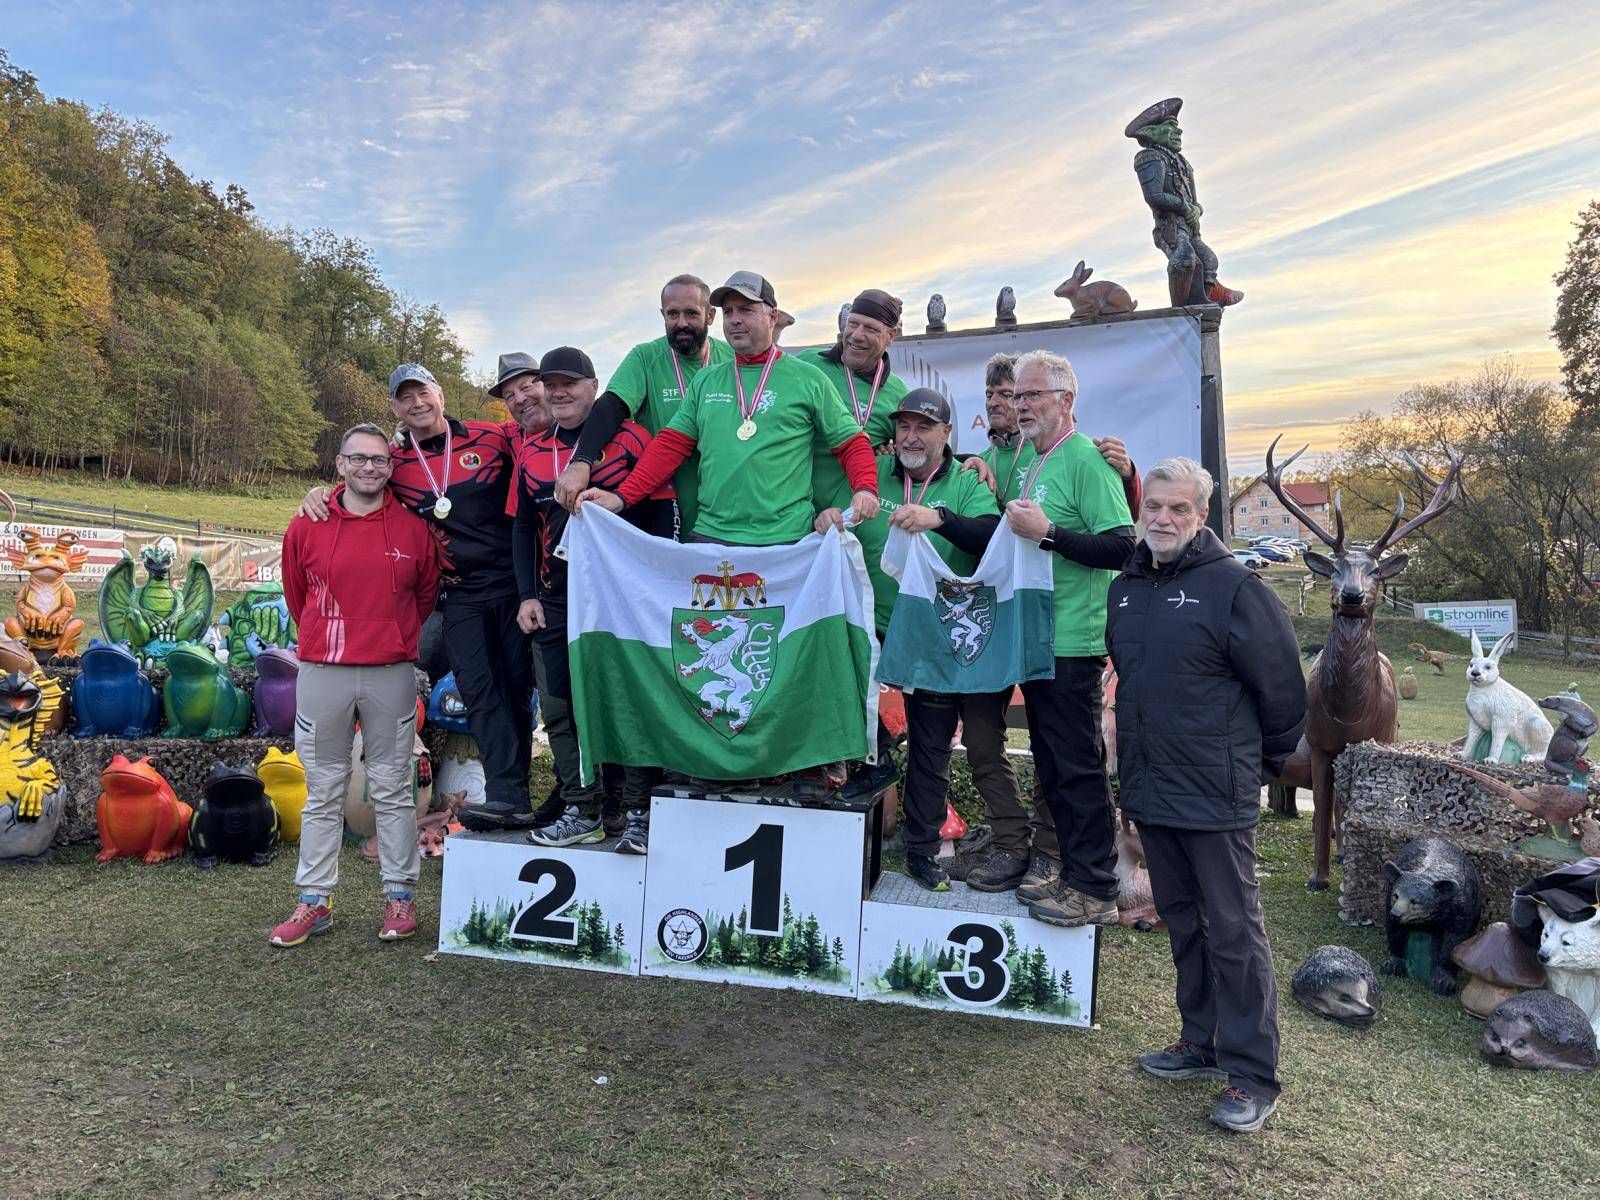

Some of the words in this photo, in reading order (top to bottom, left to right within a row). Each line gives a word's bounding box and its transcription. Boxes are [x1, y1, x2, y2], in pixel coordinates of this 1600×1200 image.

[1444, 608, 1509, 620] stromline
[514, 858, 577, 941] 2
[724, 823, 785, 933] 1
[940, 923, 1010, 1004] 3
